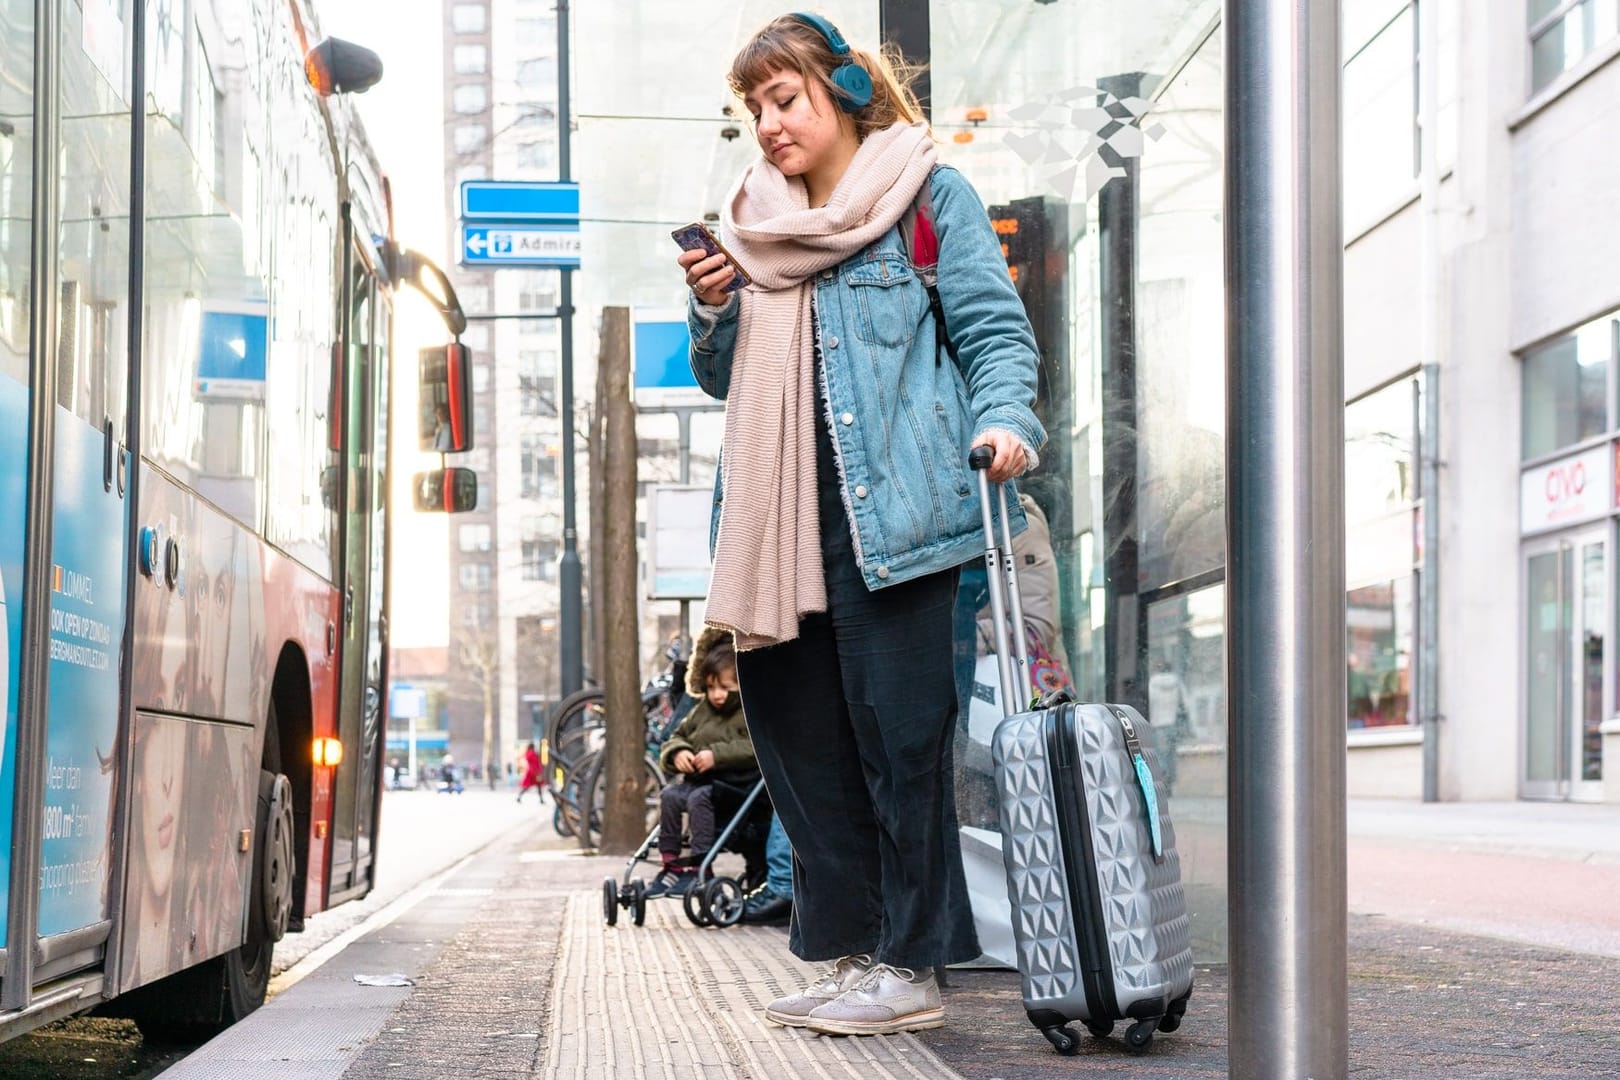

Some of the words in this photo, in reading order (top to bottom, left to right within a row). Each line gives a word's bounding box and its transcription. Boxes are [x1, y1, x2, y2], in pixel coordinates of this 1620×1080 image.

[520, 237, 581, 250] Admira
[63, 569, 94, 605] LOMMEL
[51, 609, 65, 634] OOK
[65, 612, 81, 637] OPEN
[81, 617, 90, 640] OP
[67, 756, 81, 790] dan
[43, 806, 63, 840] 1800
